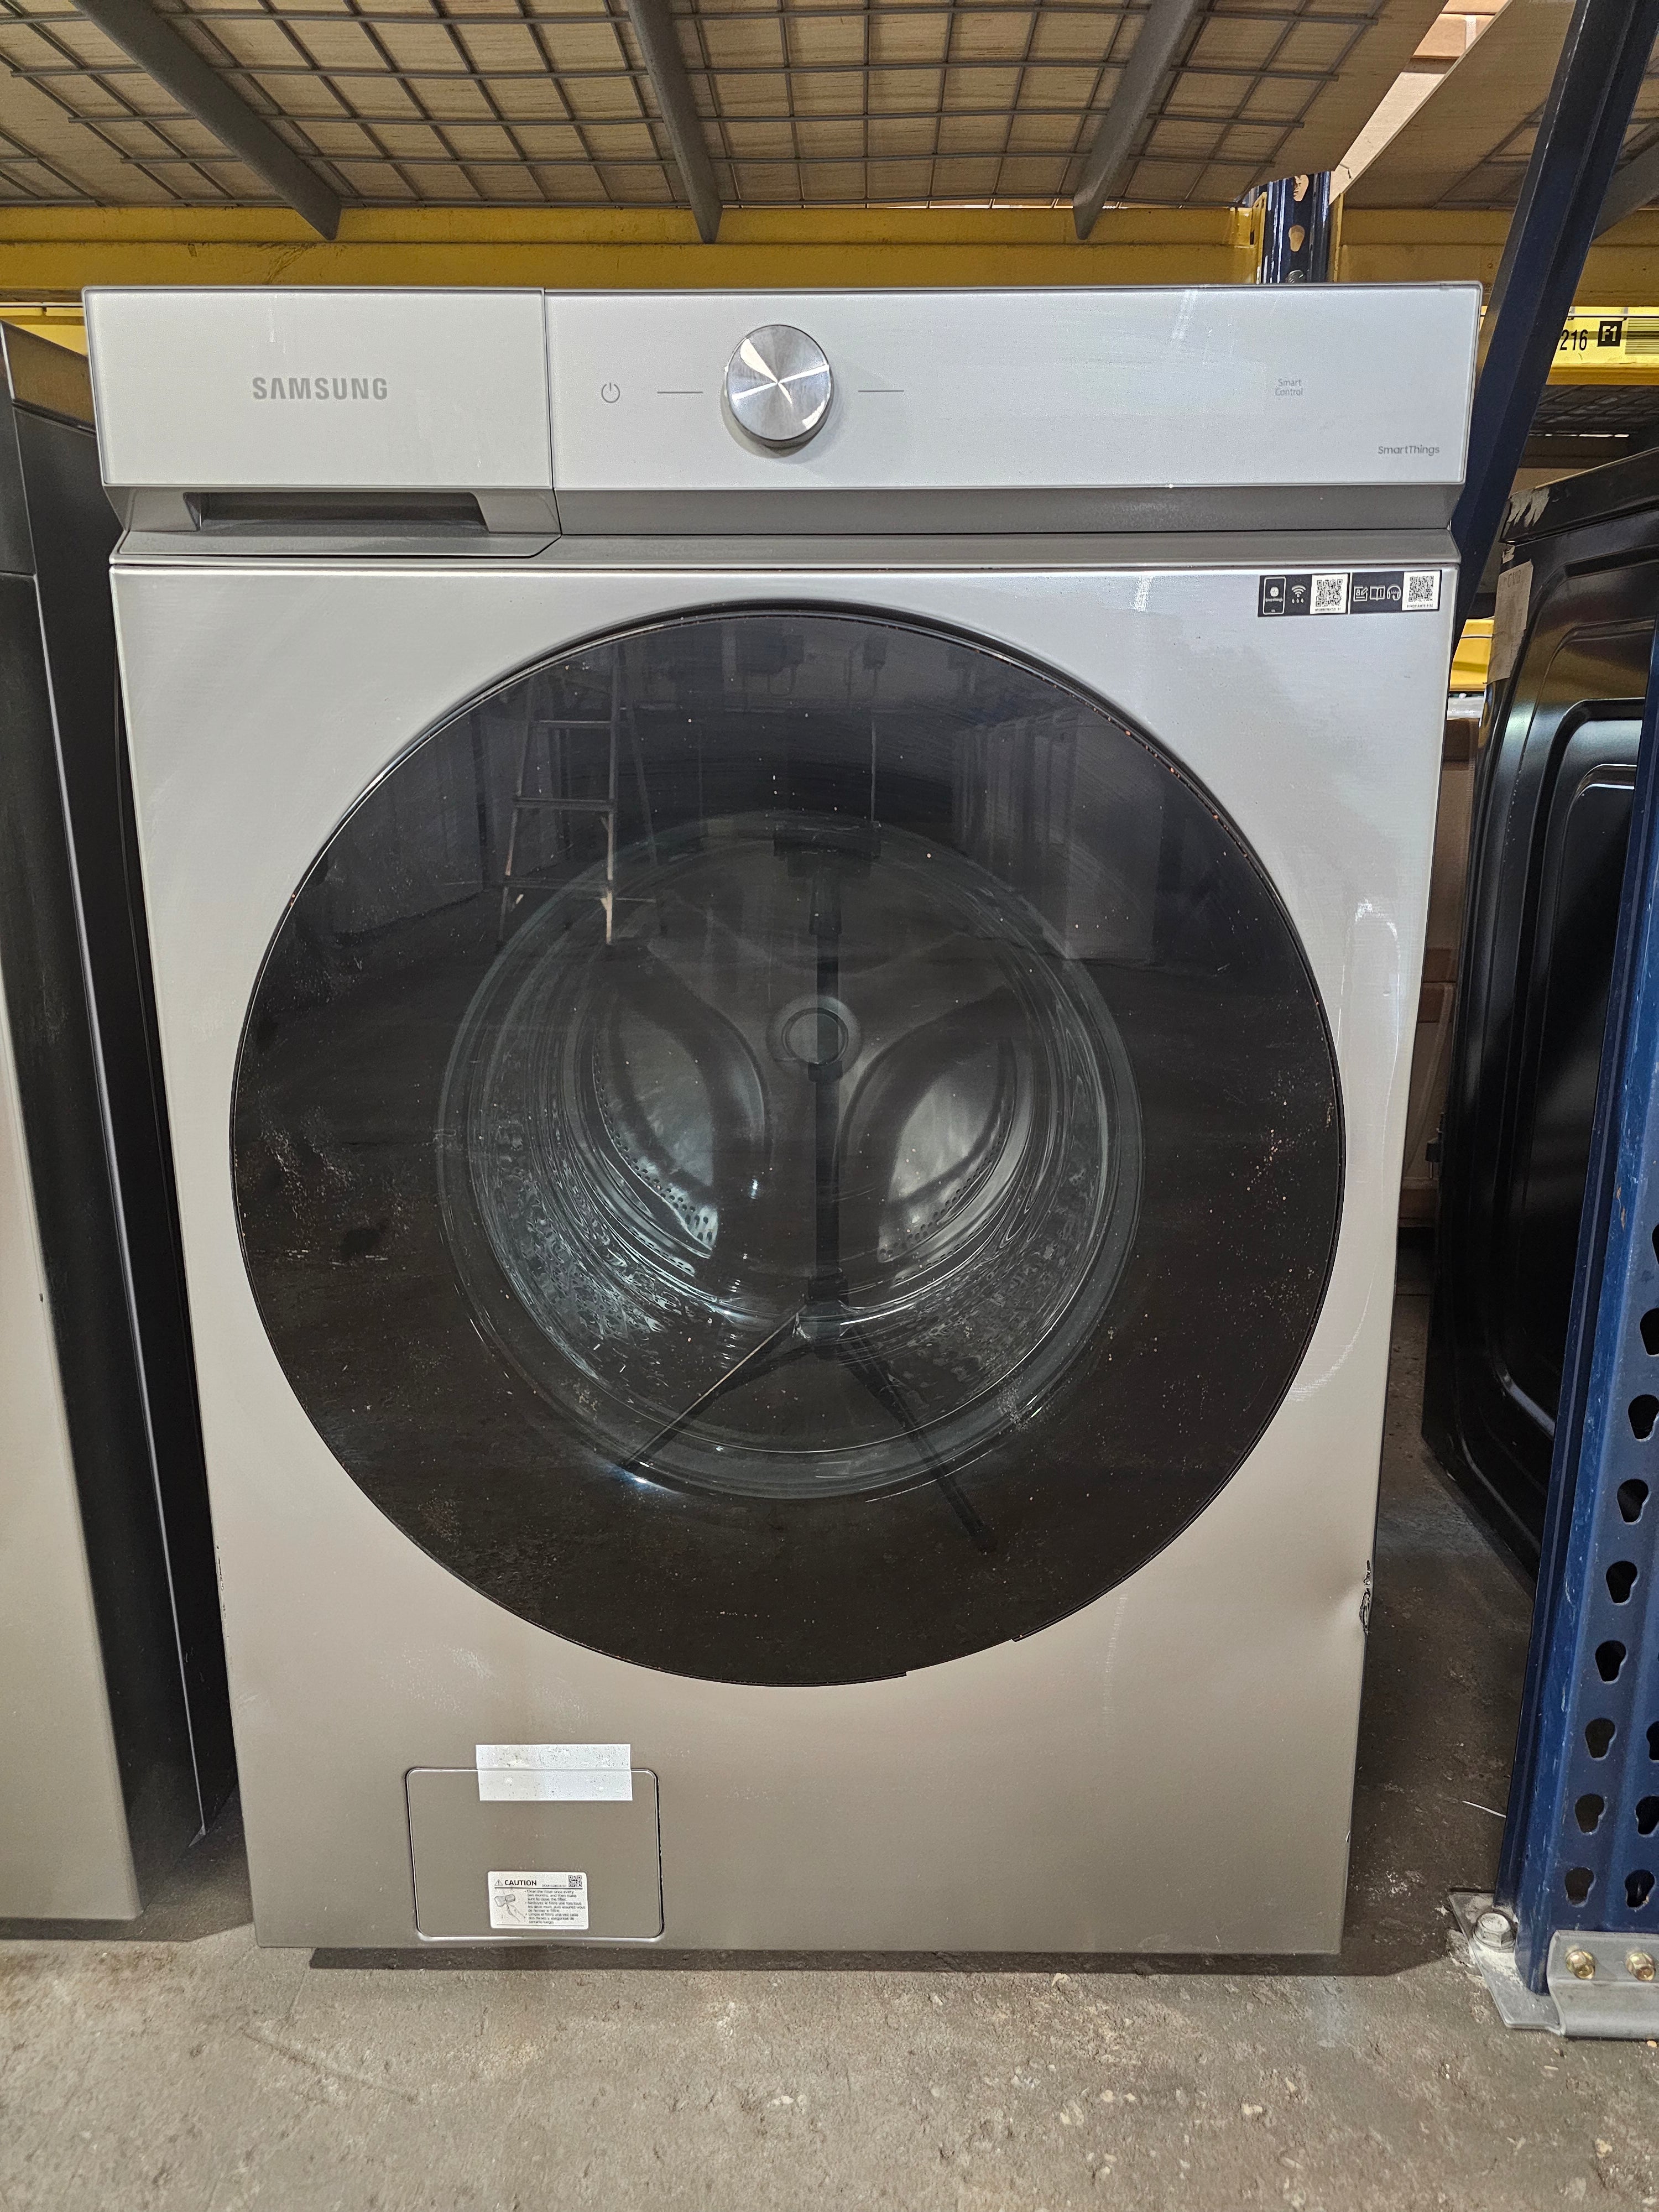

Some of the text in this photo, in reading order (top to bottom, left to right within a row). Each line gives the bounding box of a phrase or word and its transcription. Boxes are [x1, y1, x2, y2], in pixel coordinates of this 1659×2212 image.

[1601, 326, 1618, 342] F1
[252, 377, 388, 400] SAMSUNG
[1275, 388, 1303, 396] Control
[1378, 445, 1440, 456] SmartThings
